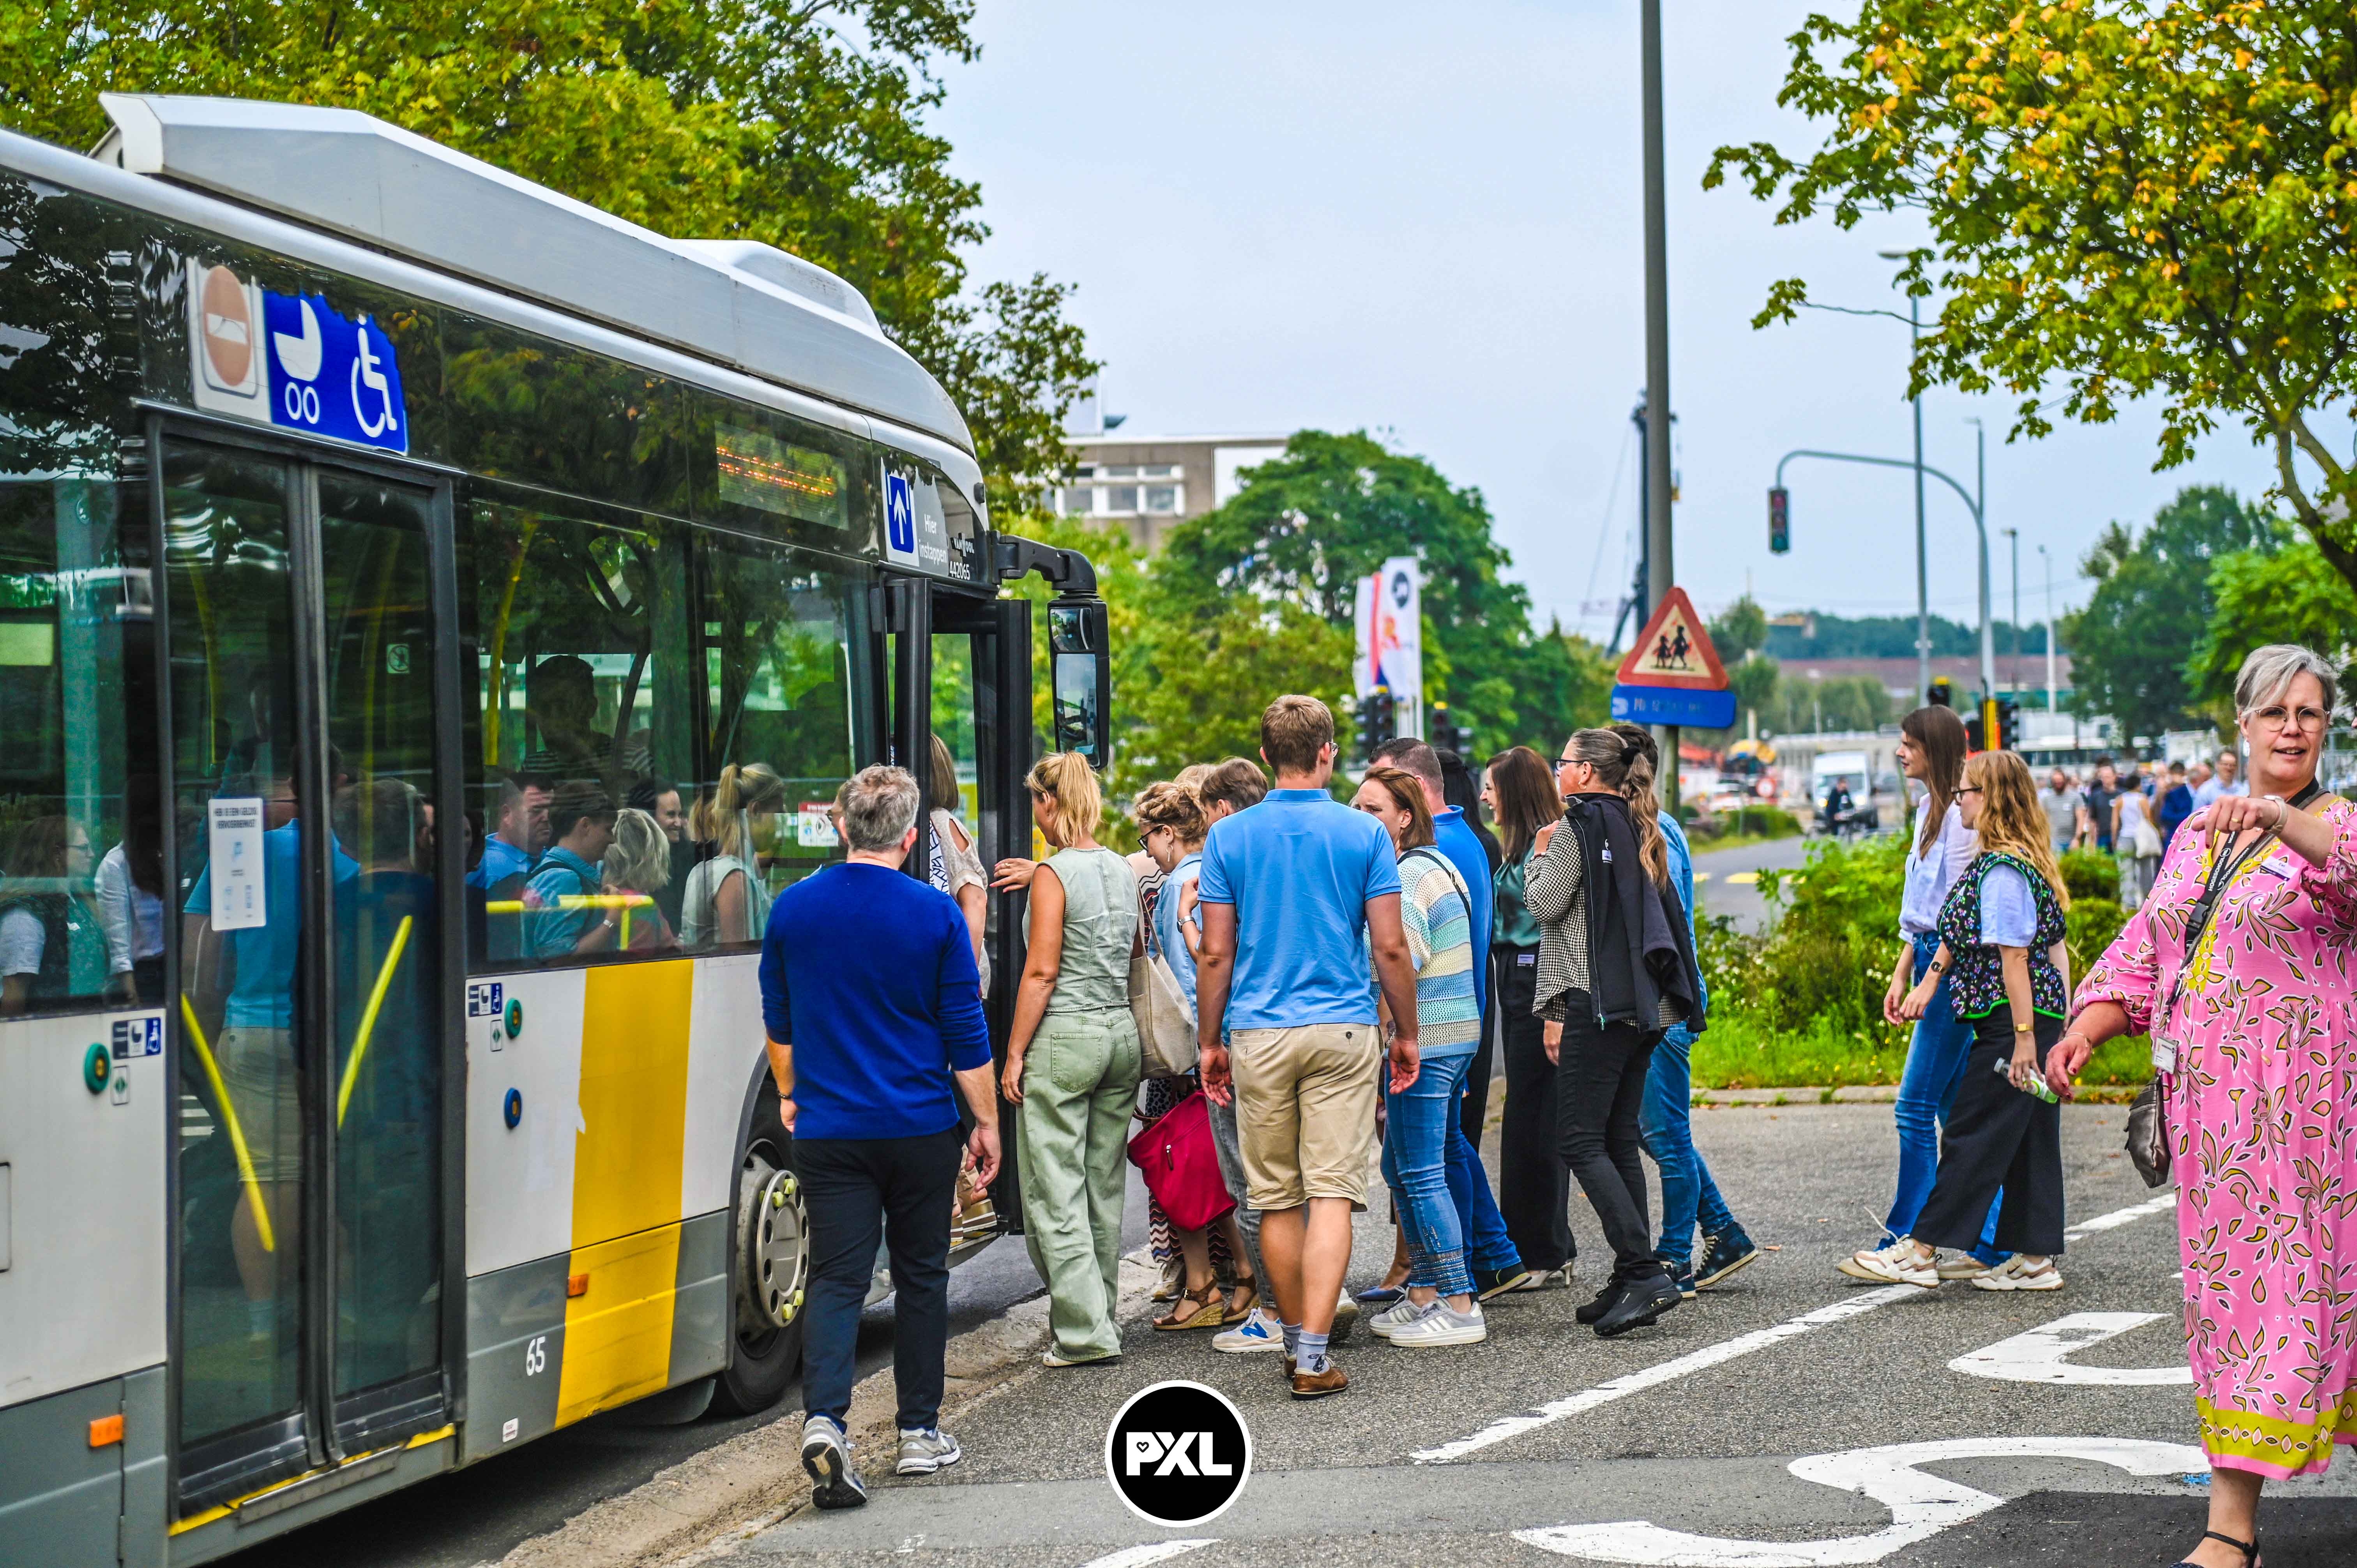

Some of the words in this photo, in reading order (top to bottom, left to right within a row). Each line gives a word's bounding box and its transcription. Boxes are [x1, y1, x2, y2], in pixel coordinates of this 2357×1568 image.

[924, 514, 936, 534] Hier
[919, 539, 948, 565] instappen
[949, 561, 970, 580] 442065
[2208, 856, 2225, 892] HOGESCHOOL
[526, 1336, 546, 1376] 65
